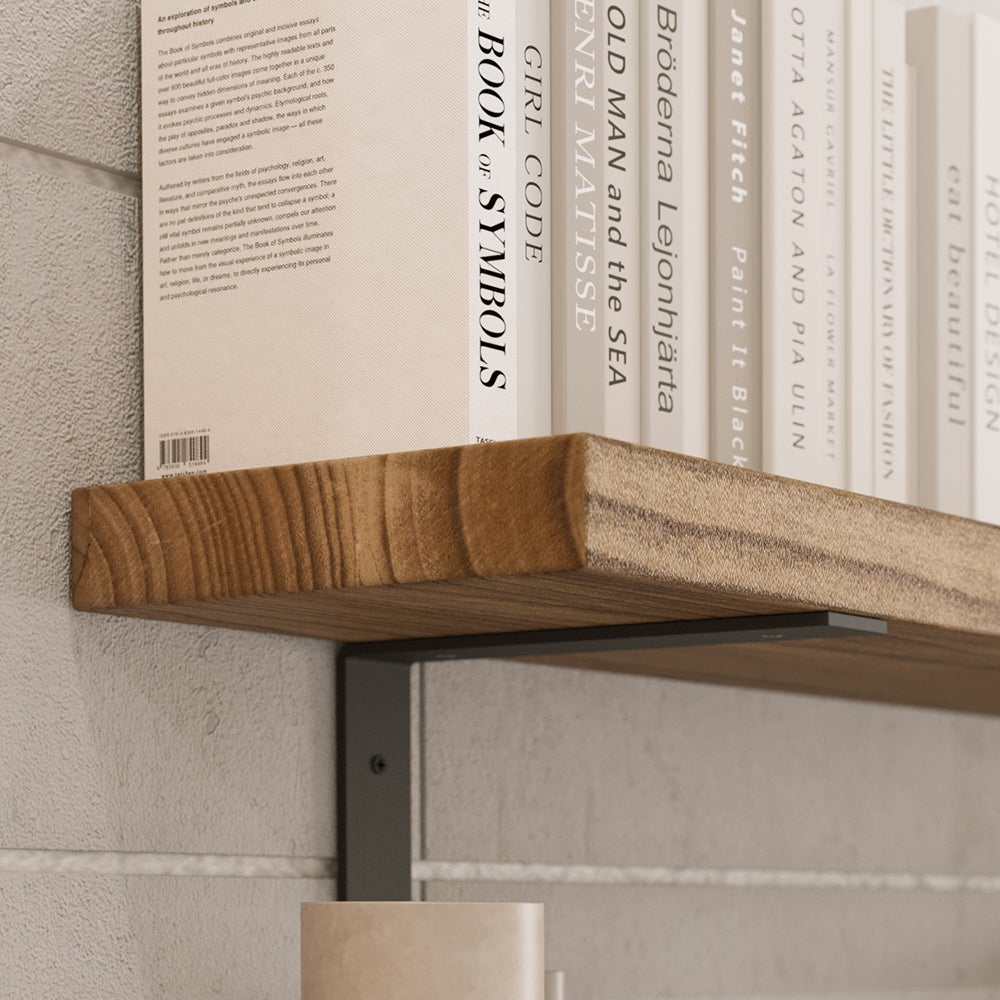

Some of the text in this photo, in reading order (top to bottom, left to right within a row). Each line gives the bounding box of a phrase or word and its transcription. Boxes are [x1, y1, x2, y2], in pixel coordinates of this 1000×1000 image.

[158, 18, 213, 34] throughout history
[158, 59, 172, 68] about
[174, 55, 198, 66] particular
[200, 50, 222, 60] symbols
[224, 46, 235, 54] with
[236, 39, 275, 52] representative
[277, 35, 297, 43] images
[321, 26, 335, 36] parts
[167, 8, 201, 20] exploration
[211, 0, 237, 11] symbols
[174, 68, 189, 77] world
[263, 50, 279, 59] highly
[281, 45, 305, 55] readable
[307, 42, 320, 50] texts
[191, 39, 214, 49] Symbols
[215, 34, 242, 44] combines
[243, 28, 263, 38] original
[298, 17, 318, 26] essays
[158, 109, 176, 117] essays
[178, 104, 204, 113] examines
[210, 100, 225, 108] given
[251, 90, 272, 100] psychic
[158, 146, 177, 154] diverse
[216, 133, 240, 143] engaged
[246, 127, 270, 138] symbolic
[272, 124, 289, 132] image
[306, 118, 322, 126] these
[523, 45, 543, 264] GIRL CODE
[574, 0, 597, 333] ENRI MATISSE
[159, 180, 183, 190] Authored
[192, 176, 210, 184] writers
[235, 168, 249, 176] fields
[244, 188, 276, 200] unexpected
[477, 0, 507, 390] HE BOOK OF SYMBOLS
[606, 4, 627, 387] OLD MAN and the SEA
[652, 4, 678, 414] Bröderna Lejonhjärta
[730, 9, 747, 469] Janet Fitch Paint It Black
[790, 7, 806, 451] OTTA AGATON AND PIA ULIN
[159, 256, 177, 264] Rather
[192, 250, 210, 258] merely
[277, 234, 301, 244] Symbols
[302, 230, 332, 240] illuminates
[171, 287, 206, 300] psychological
[825, 29, 836, 462] MANSUR GAVRIEL LA FLOWER MARKET
[881, 67, 894, 482] THE LITTLE DICTIONARY OF FASHION
[947, 164, 966, 428] eat beautiful
[984, 175, 1000, 434] HOTEL DESIGN
